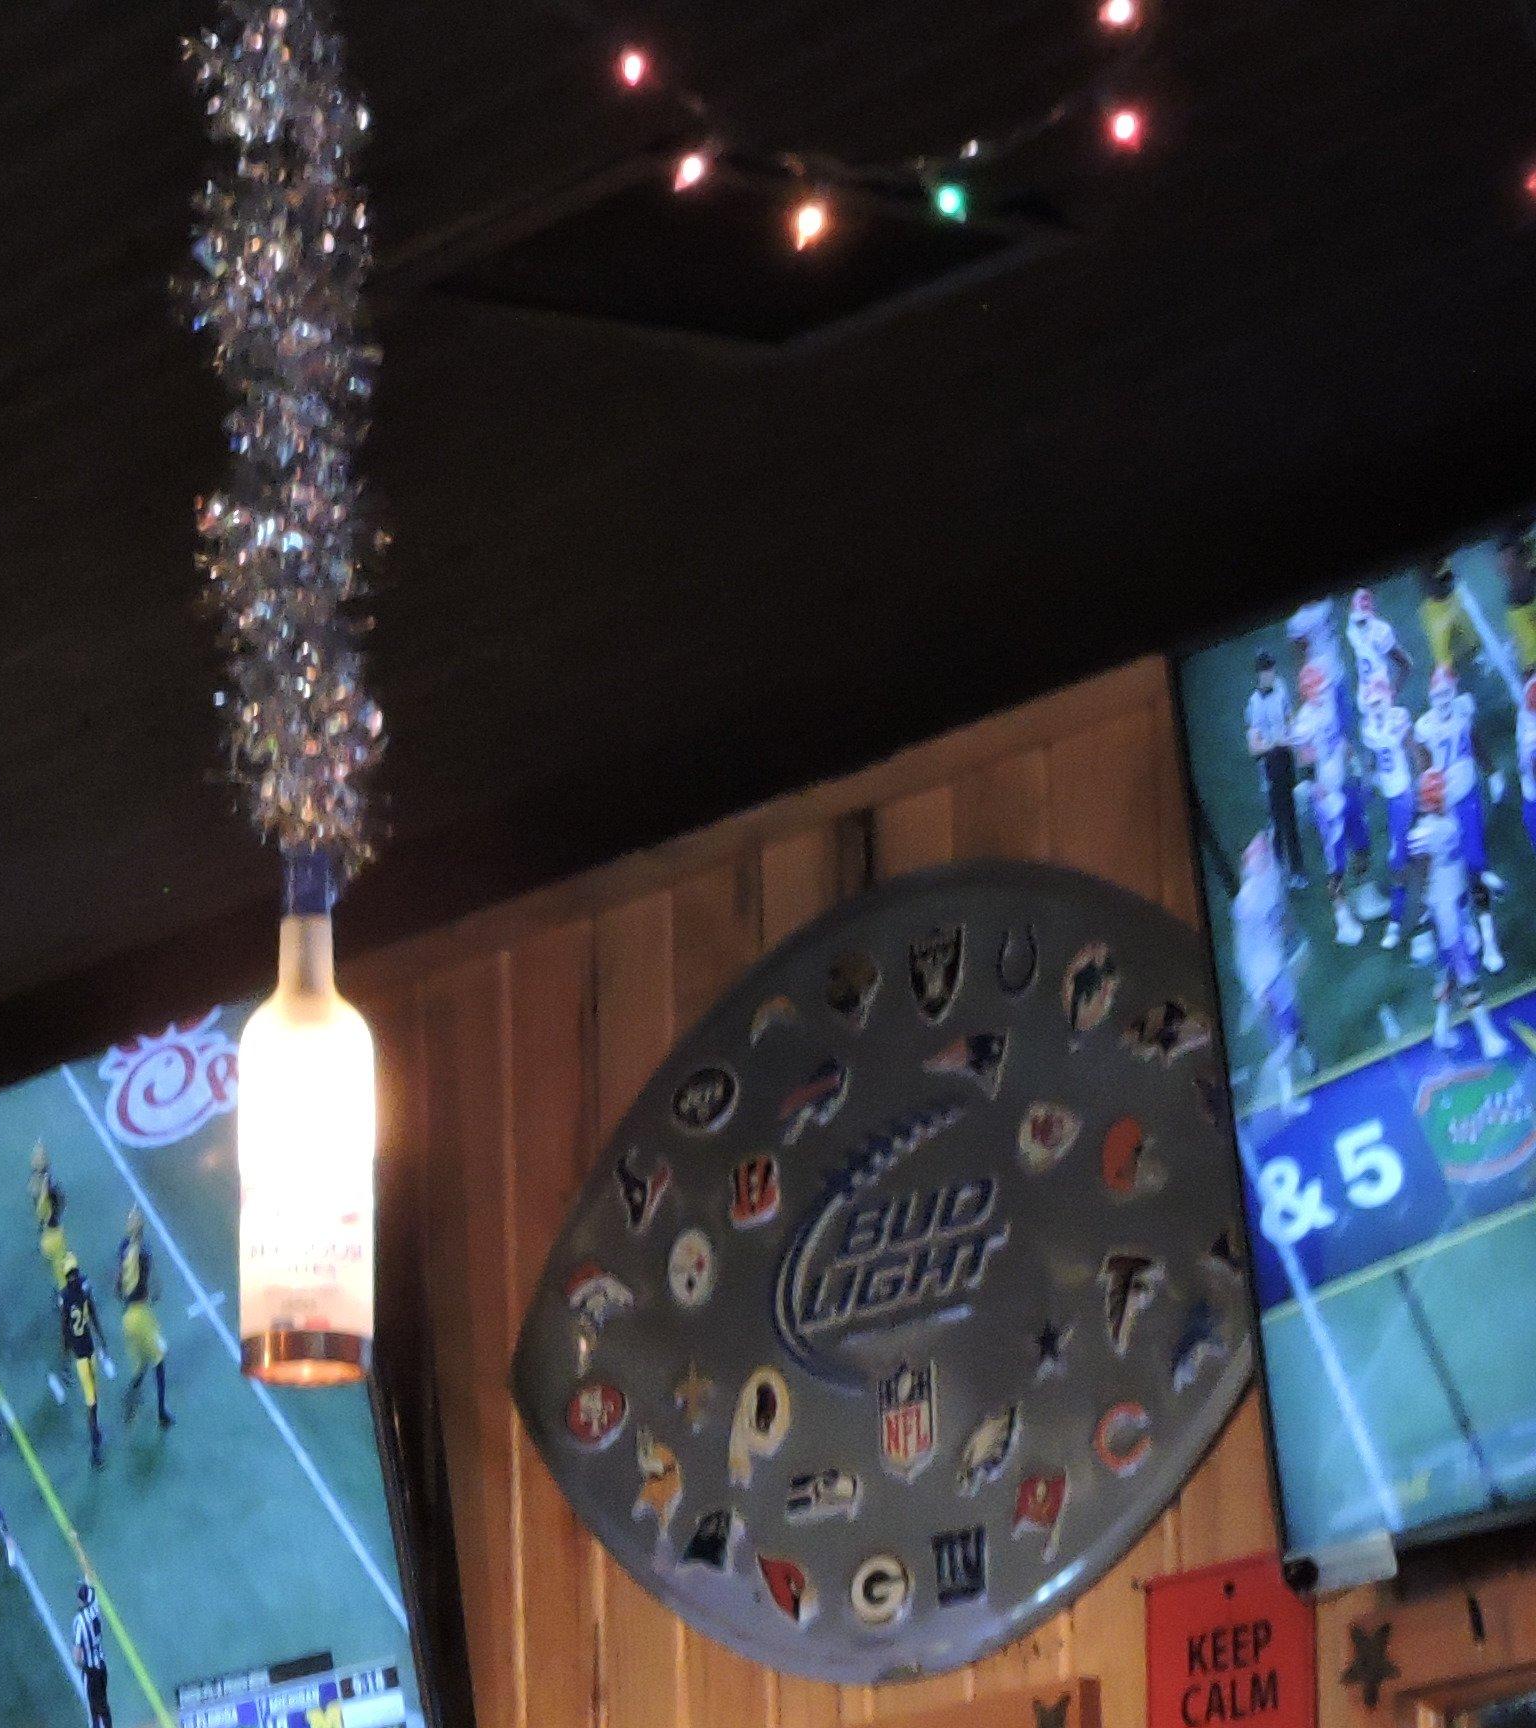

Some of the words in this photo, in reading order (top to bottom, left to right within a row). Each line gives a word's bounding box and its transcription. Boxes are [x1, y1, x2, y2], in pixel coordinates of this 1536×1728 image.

[1332, 1120, 1405, 1209] 5
[836, 1175, 998, 1265] BUD
[796, 1222, 1013, 1335] LIGHT
[1185, 1618, 1274, 1678] KEEP
